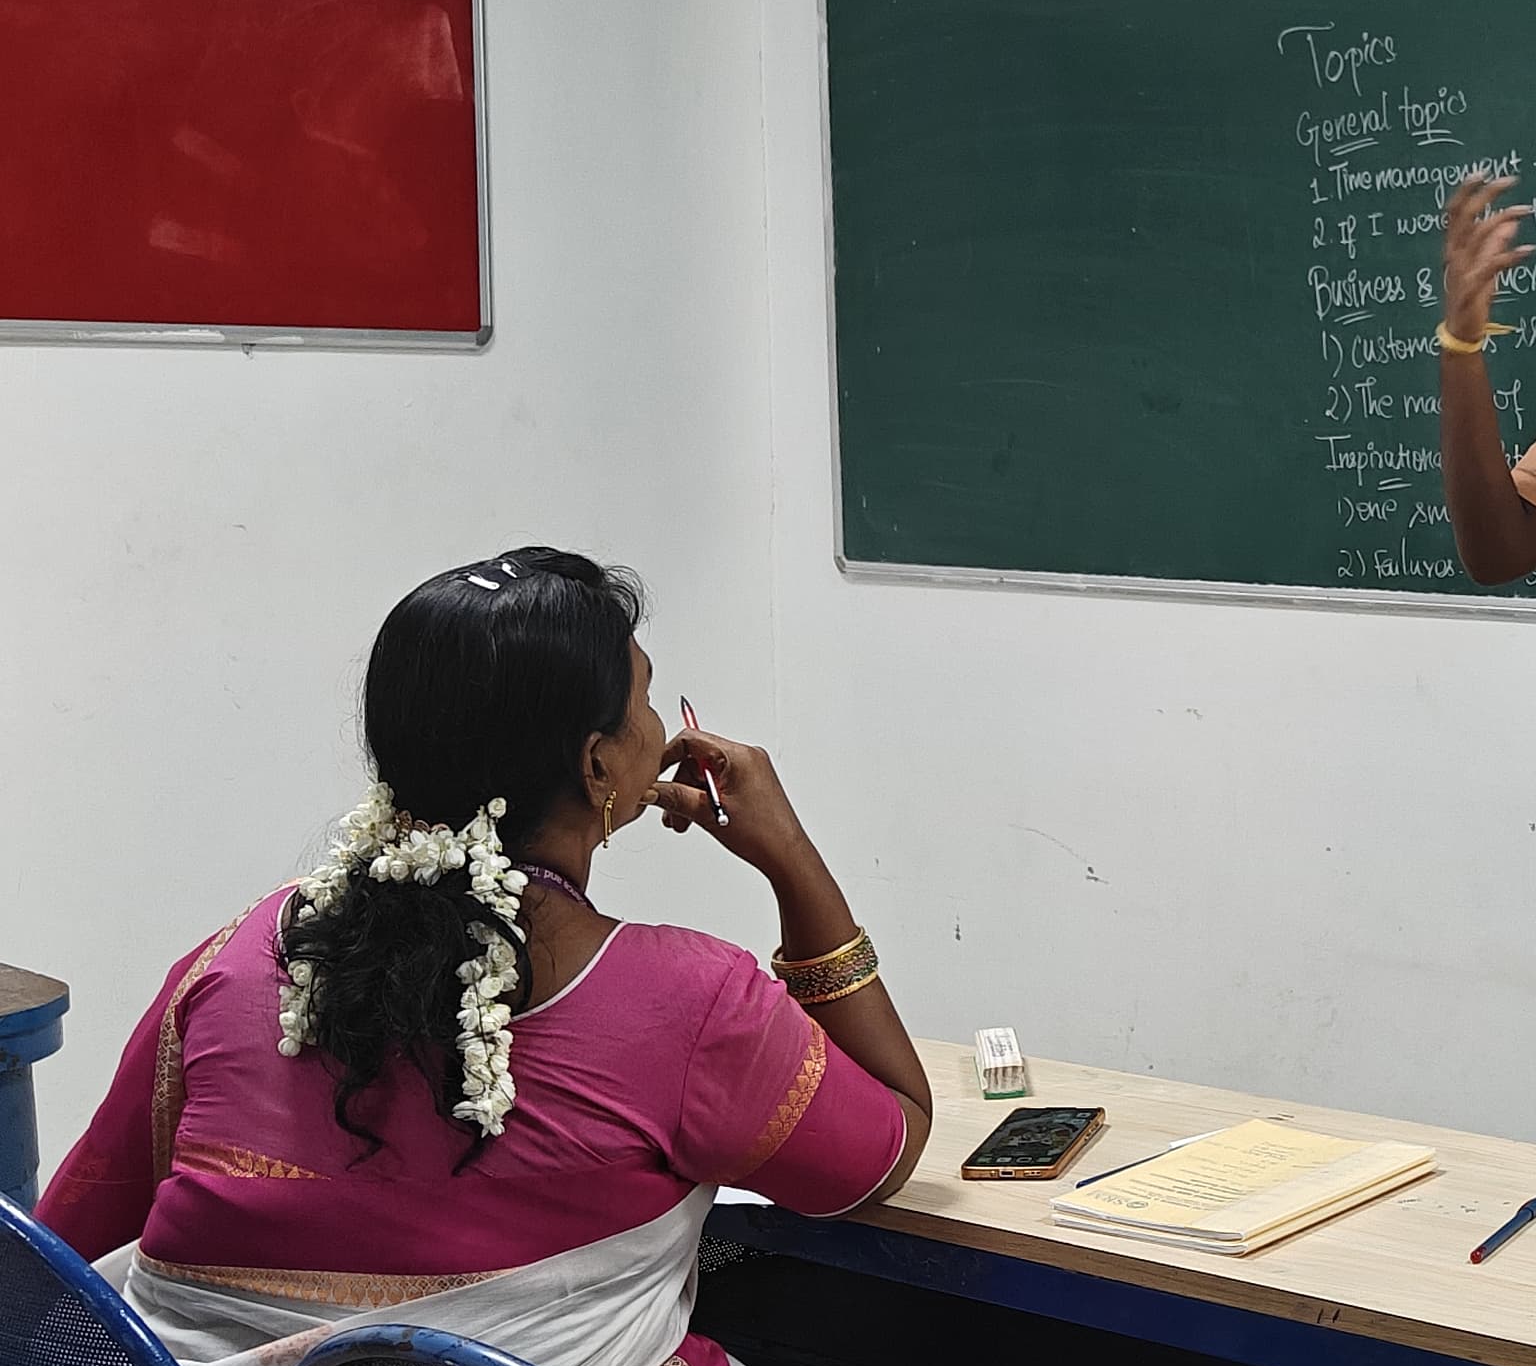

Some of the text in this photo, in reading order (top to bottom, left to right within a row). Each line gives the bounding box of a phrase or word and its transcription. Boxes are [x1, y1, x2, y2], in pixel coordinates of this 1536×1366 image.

[1277, 21, 1398, 97] Topics
[1296, 85, 1467, 167] General topics
[1308, 265, 1406, 321] Business
[1416, 267, 1434, 299] &
[1354, 376, 1394, 419] The
